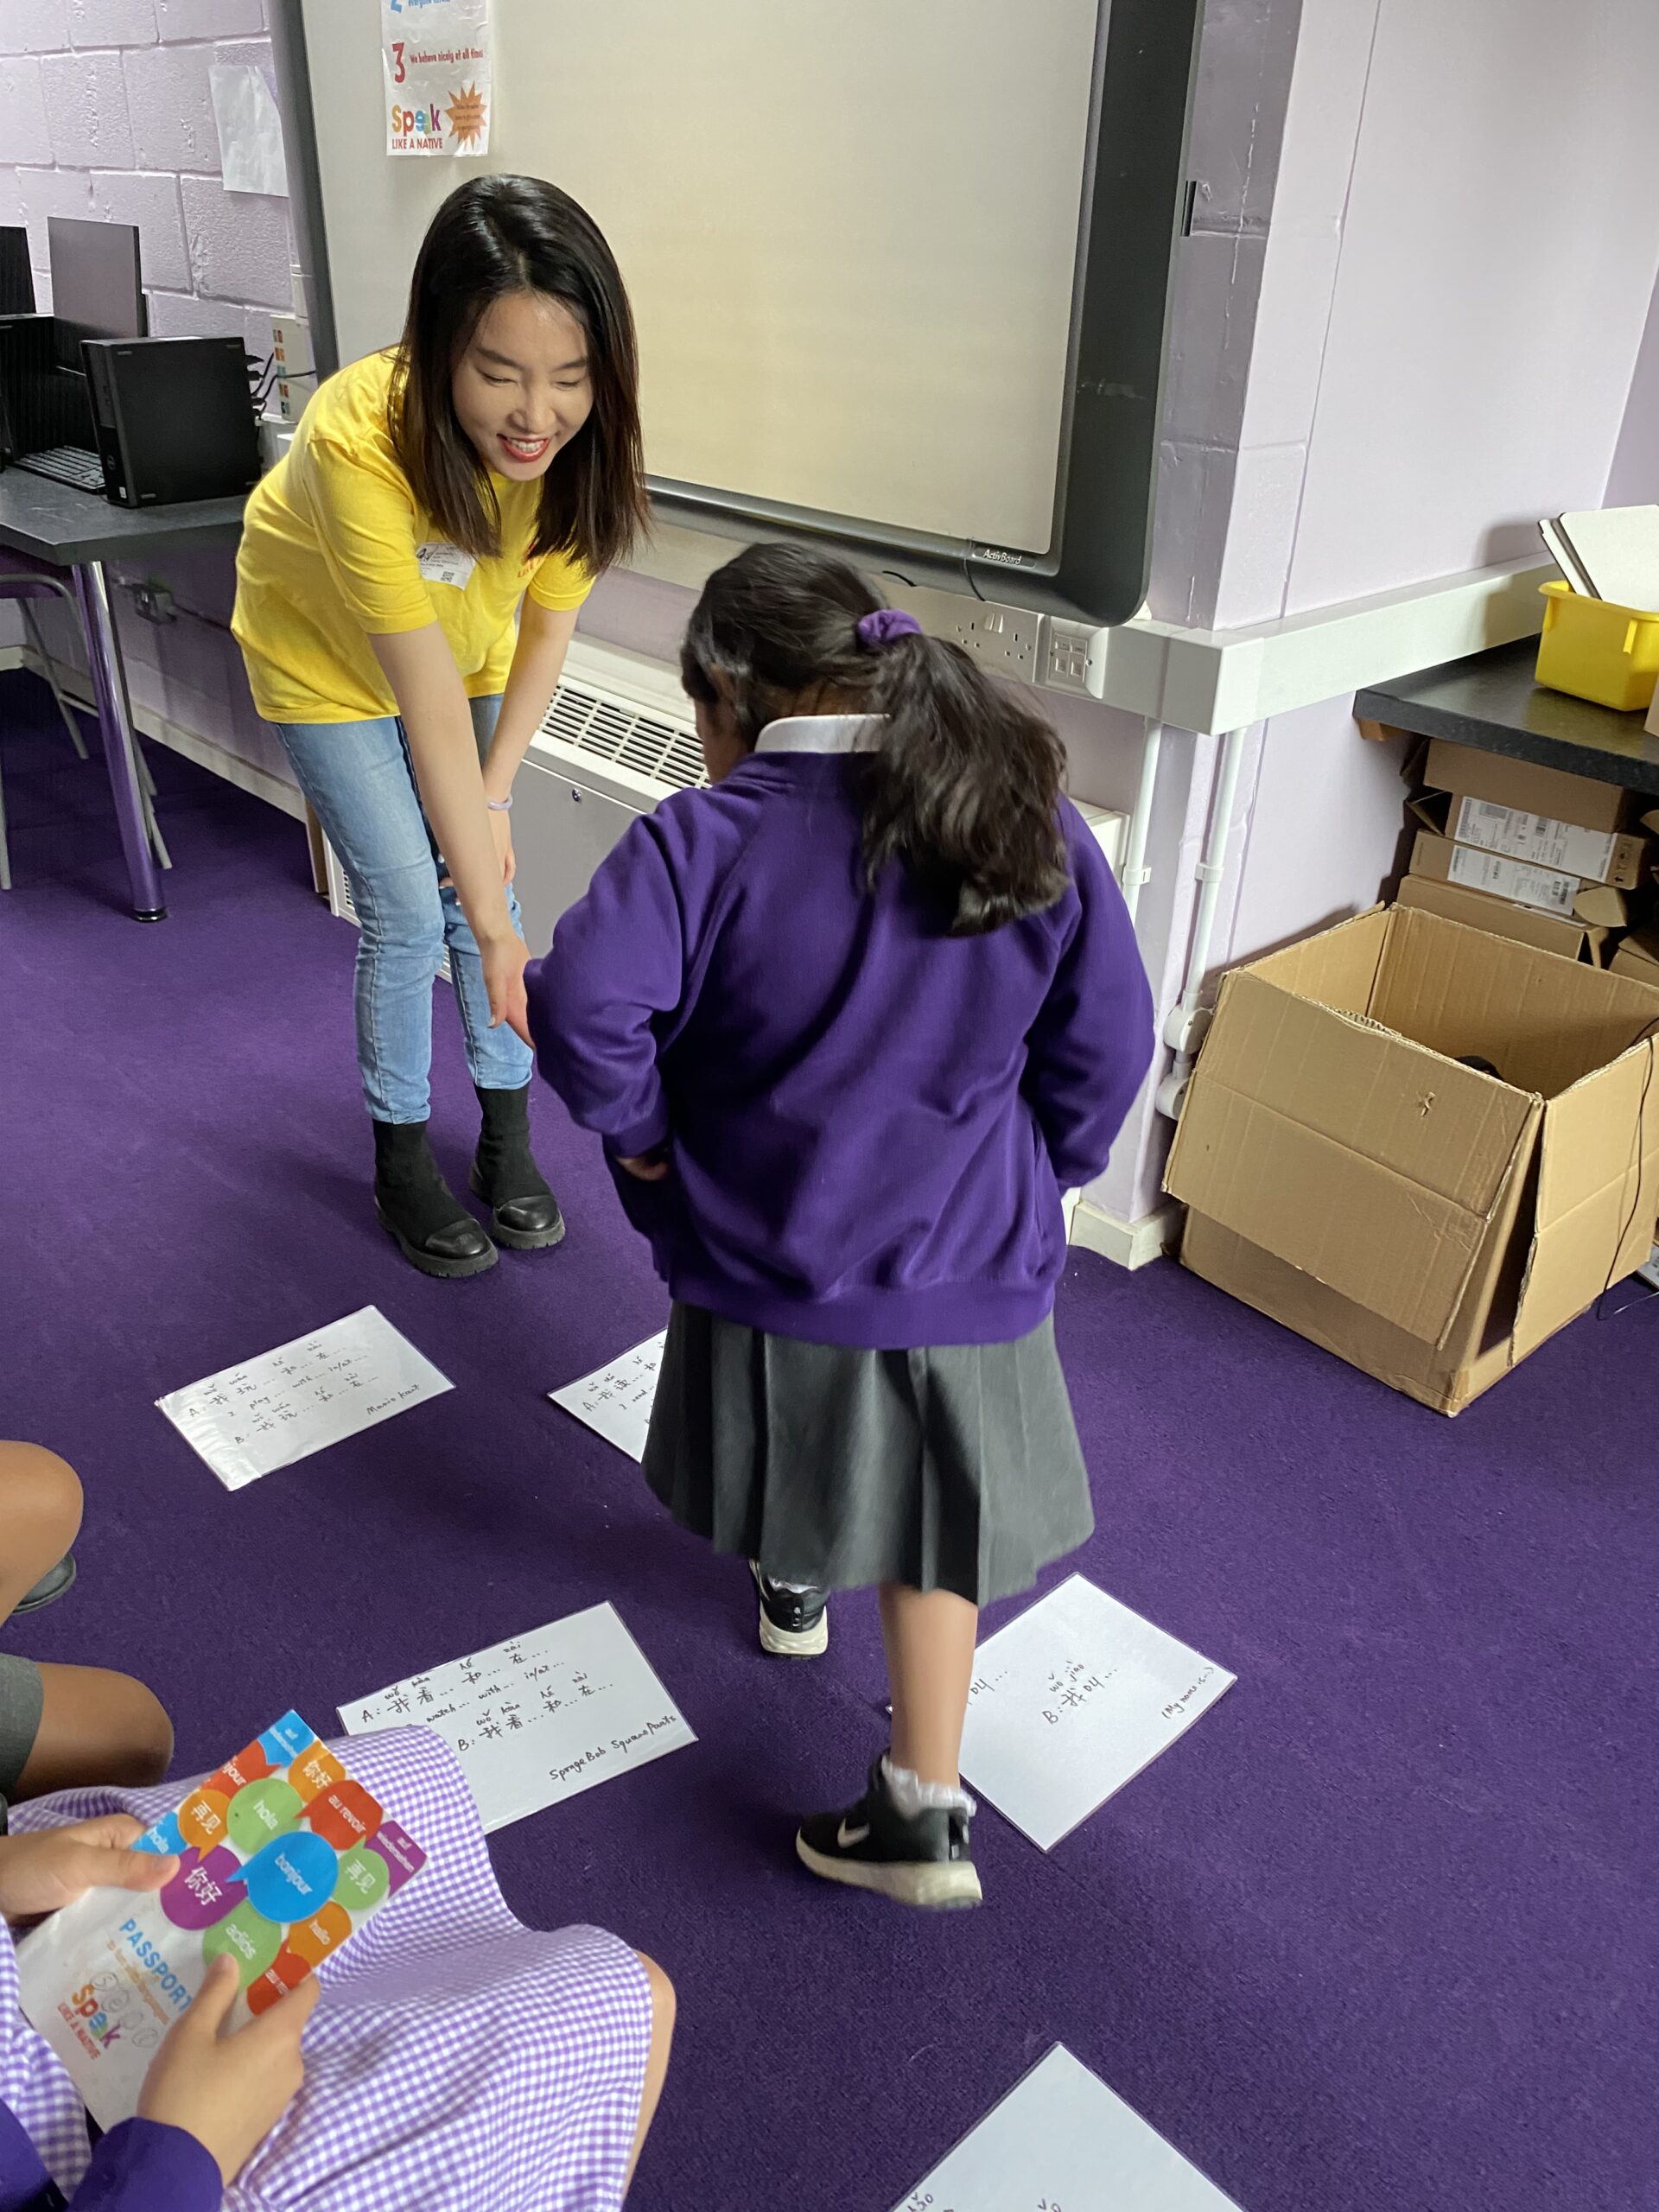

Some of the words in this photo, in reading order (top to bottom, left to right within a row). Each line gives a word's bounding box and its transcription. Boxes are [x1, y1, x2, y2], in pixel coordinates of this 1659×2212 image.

[392, 42, 405, 83] 3
[392, 138, 407, 149] LIKE
[410, 138, 415, 149] A
[416, 137, 443, 149] NATIVE
[983, 549, 1022, 564] ActivBoard
[302, 1759, 333, 1789] 你好
[191, 1800, 221, 1835] 再见
[253, 1799, 278, 1830] hola
[327, 1795, 343, 1810] au
[340, 1807, 366, 1834] revoir
[184, 1866, 223, 1906] 你好
[275, 1853, 313, 1895] bonjour
[346, 1859, 376, 1895] 再见
[119, 1917, 194, 2012] PASSPORT
